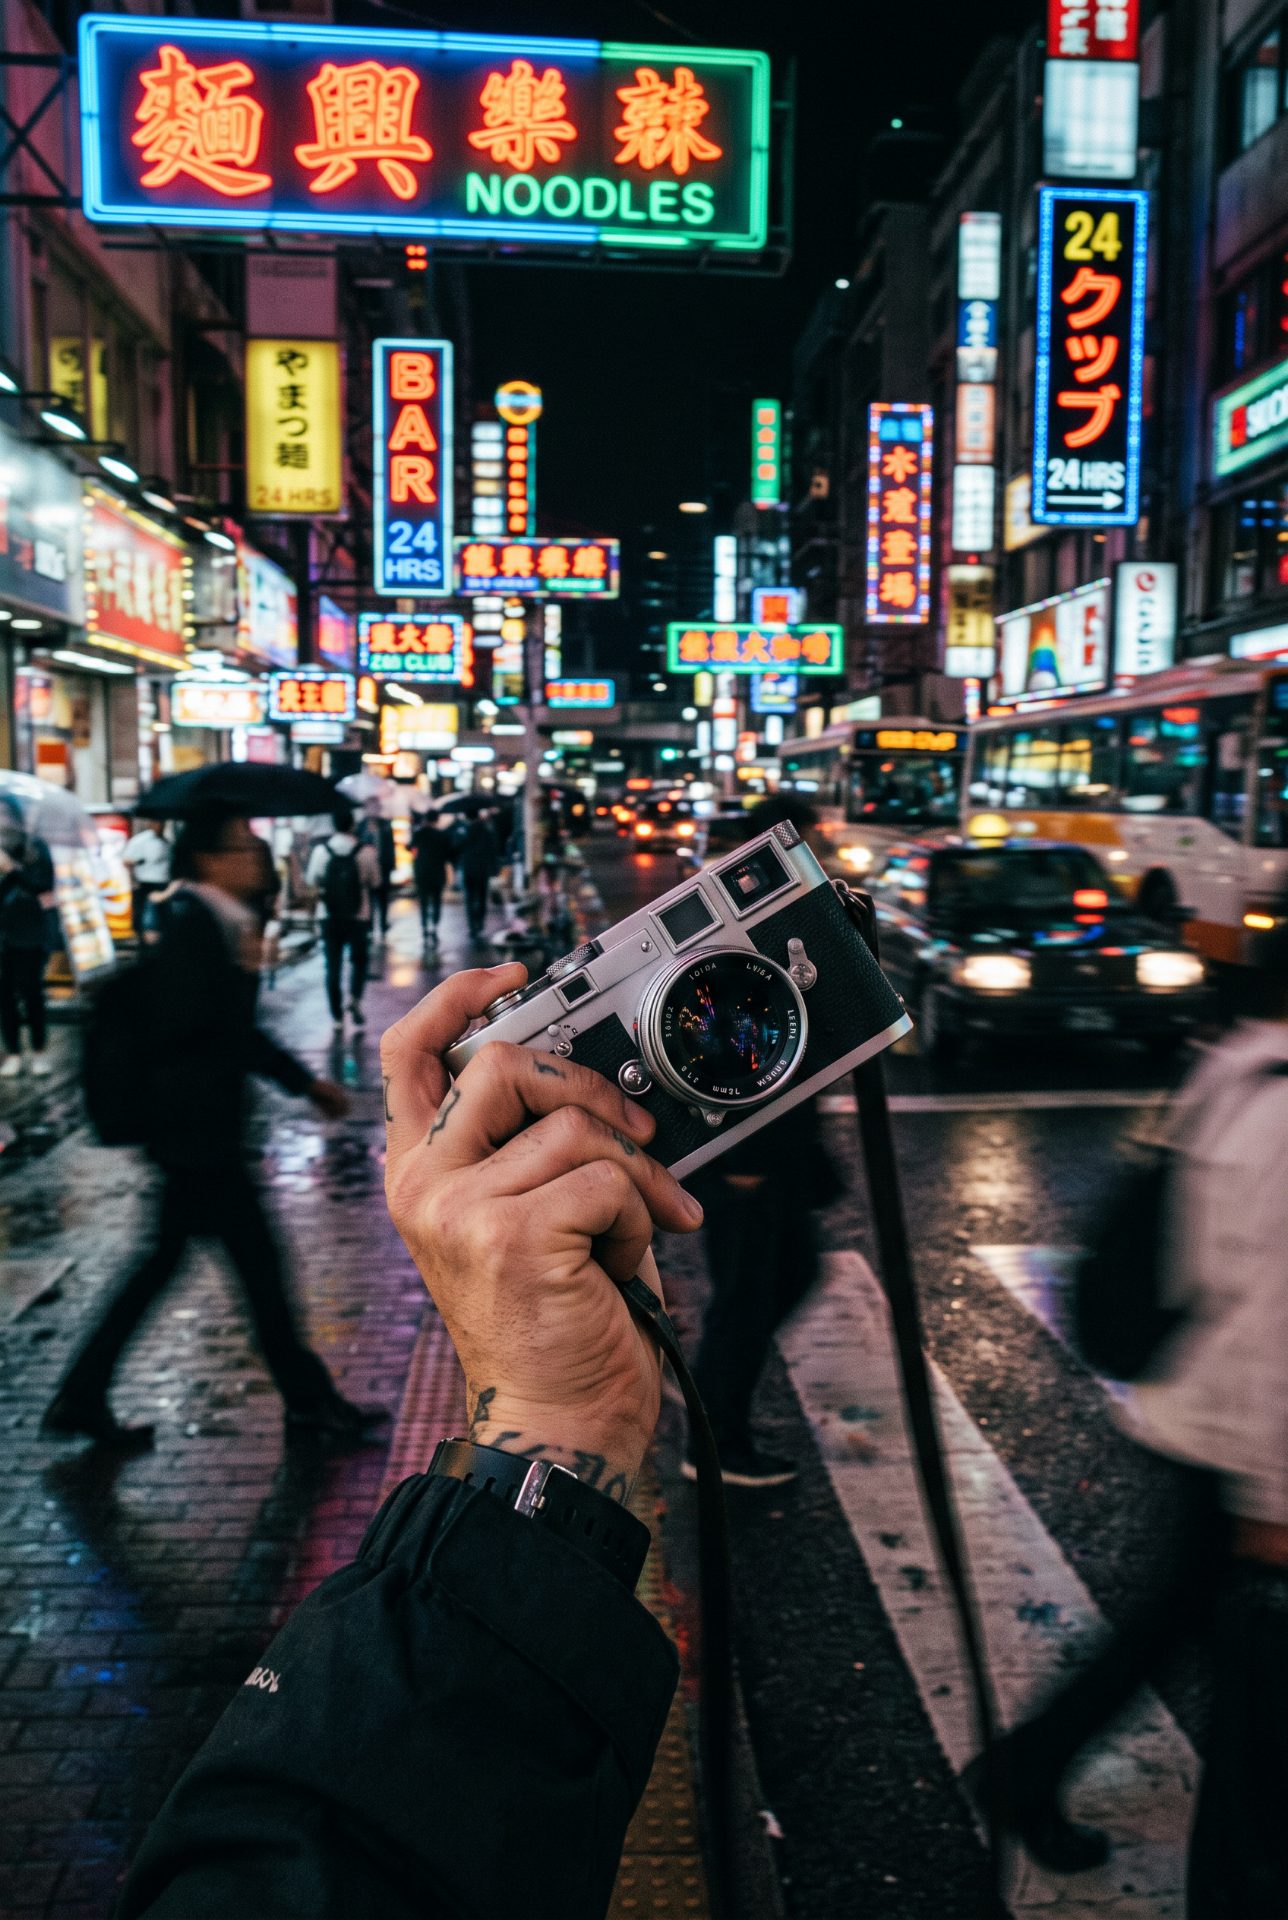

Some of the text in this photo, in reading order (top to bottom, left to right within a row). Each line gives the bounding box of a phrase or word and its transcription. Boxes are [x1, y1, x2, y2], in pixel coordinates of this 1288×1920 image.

[465, 171, 716, 225] NOODLES
[1064, 210, 1122, 262] 24
[387, 351, 438, 504] BAR
[1047, 457, 1126, 491] 24 HRS
[256, 484, 333, 507] 24 HRS
[387, 520, 438, 555] 24
[384, 557, 442, 583] HRS
